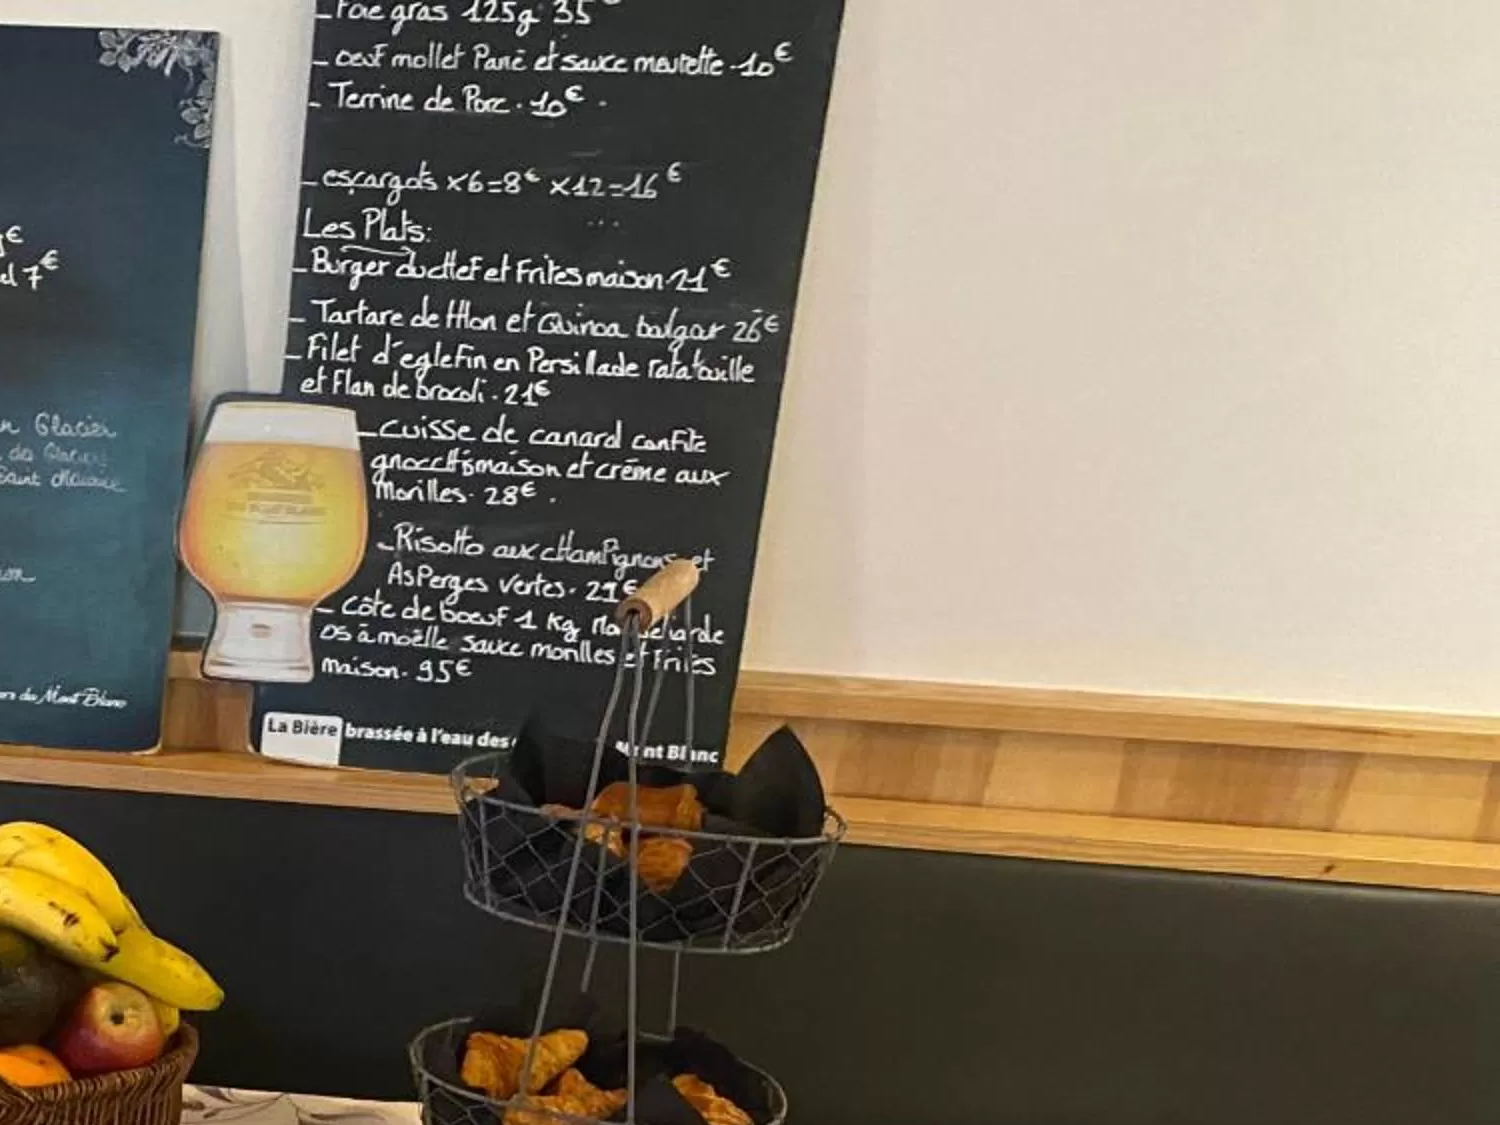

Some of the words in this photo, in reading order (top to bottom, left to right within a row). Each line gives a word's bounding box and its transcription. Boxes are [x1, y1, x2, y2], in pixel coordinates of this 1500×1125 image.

[390, 2, 448, 36] gras
[461, 0, 540, 36] 125g
[392, 41, 464, 69] mollet
[534, 40, 558, 71] et
[560, 54, 628, 72] sauce
[328, 80, 414, 111] Terrine
[424, 84, 455, 112] de
[462, 84, 510, 113] Porc
[322, 160, 438, 206] escargots
[302, 207, 356, 239] Les
[312, 245, 391, 291] Burger
[396, 249, 426, 279] du
[484, 253, 511, 282] et
[516, 254, 582, 286] Frites
[586, 259, 664, 290] maison
[310, 298, 404, 327] Tartare
[410, 295, 440, 328] de
[506, 300, 536, 333] et
[307, 331, 362, 362] Filet
[493, 356, 520, 372] en
[300, 365, 328, 394] et
[383, 370, 412, 399] de
[482, 413, 519, 444] de
[528, 419, 623, 449] canard
[475, 450, 562, 477] maison
[566, 450, 595, 479] et
[675, 468, 731, 486] aux
[393, 521, 485, 555] Risotto
[492, 543, 541, 560] aux
[691, 548, 715, 571] et
[401, 594, 437, 621] de
[514, 609, 537, 630] 1
[460, 634, 525, 657] sauce
[268, 718, 287, 734] La
[292, 719, 338, 737] Bière
[345, 722, 413, 743] brassée
[416, 728, 428, 743] à
[432, 728, 473, 747] l'eau
[477, 731, 509, 749] des
